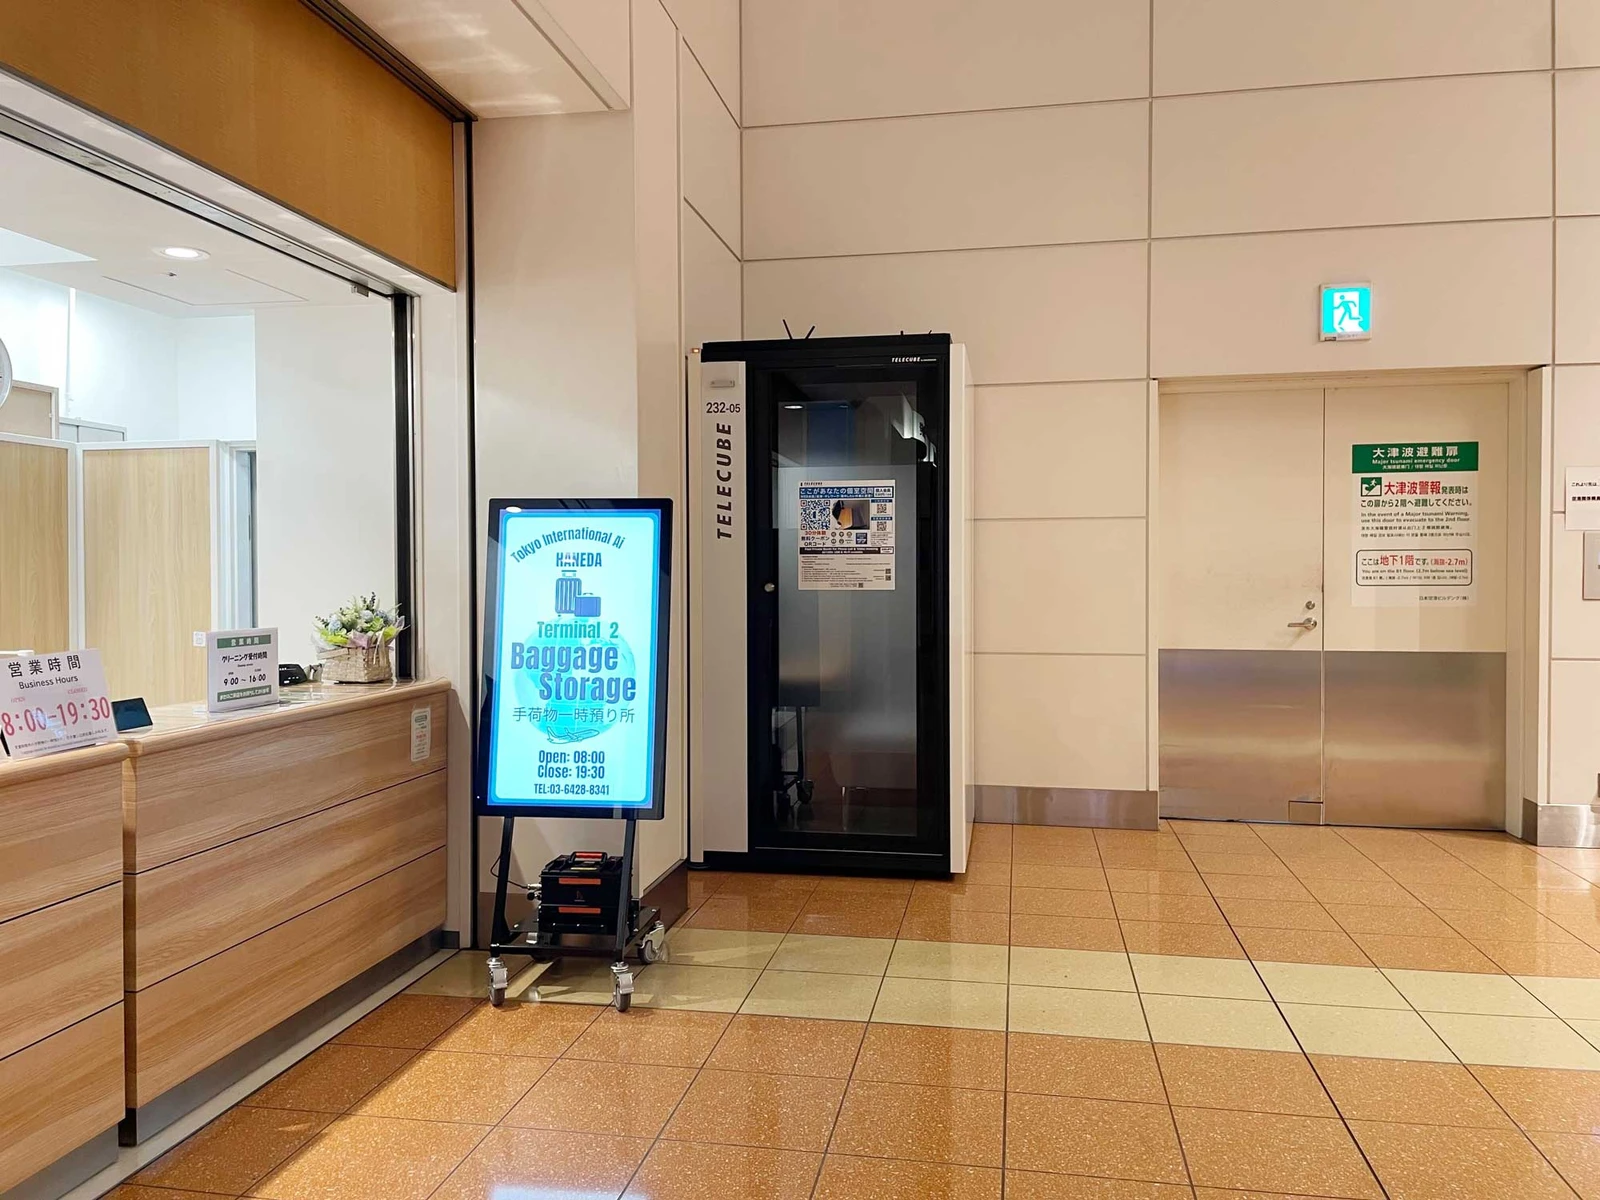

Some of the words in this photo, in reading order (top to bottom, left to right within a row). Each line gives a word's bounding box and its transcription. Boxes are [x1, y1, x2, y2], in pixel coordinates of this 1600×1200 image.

[706, 402, 741, 414] 232-05
[716, 423, 732, 539] TELECUBE
[510, 539, 542, 563] Tokyo
[542, 526, 613, 546] International
[556, 552, 602, 567] HANEDA
[537, 620, 601, 639] Terminal
[609, 622, 619, 639] 2
[8, 654, 82, 678] 営業時間
[511, 642, 619, 673] Baggage
[19, 678, 55, 690] Business
[55, 675, 79, 685] Hours
[223, 677, 239, 687] 900
[249, 673, 267, 683] 1600
[539, 672, 637, 704] Storage
[512, 706, 636, 724] 手荷物一時預り所
[538, 750, 571, 767] Open:
[573, 750, 605, 764] 08:00
[537, 764, 572, 778] Close:
[575, 765, 605, 779] 19:30
[533, 783, 610, 796] TEL:03-6428-8341
